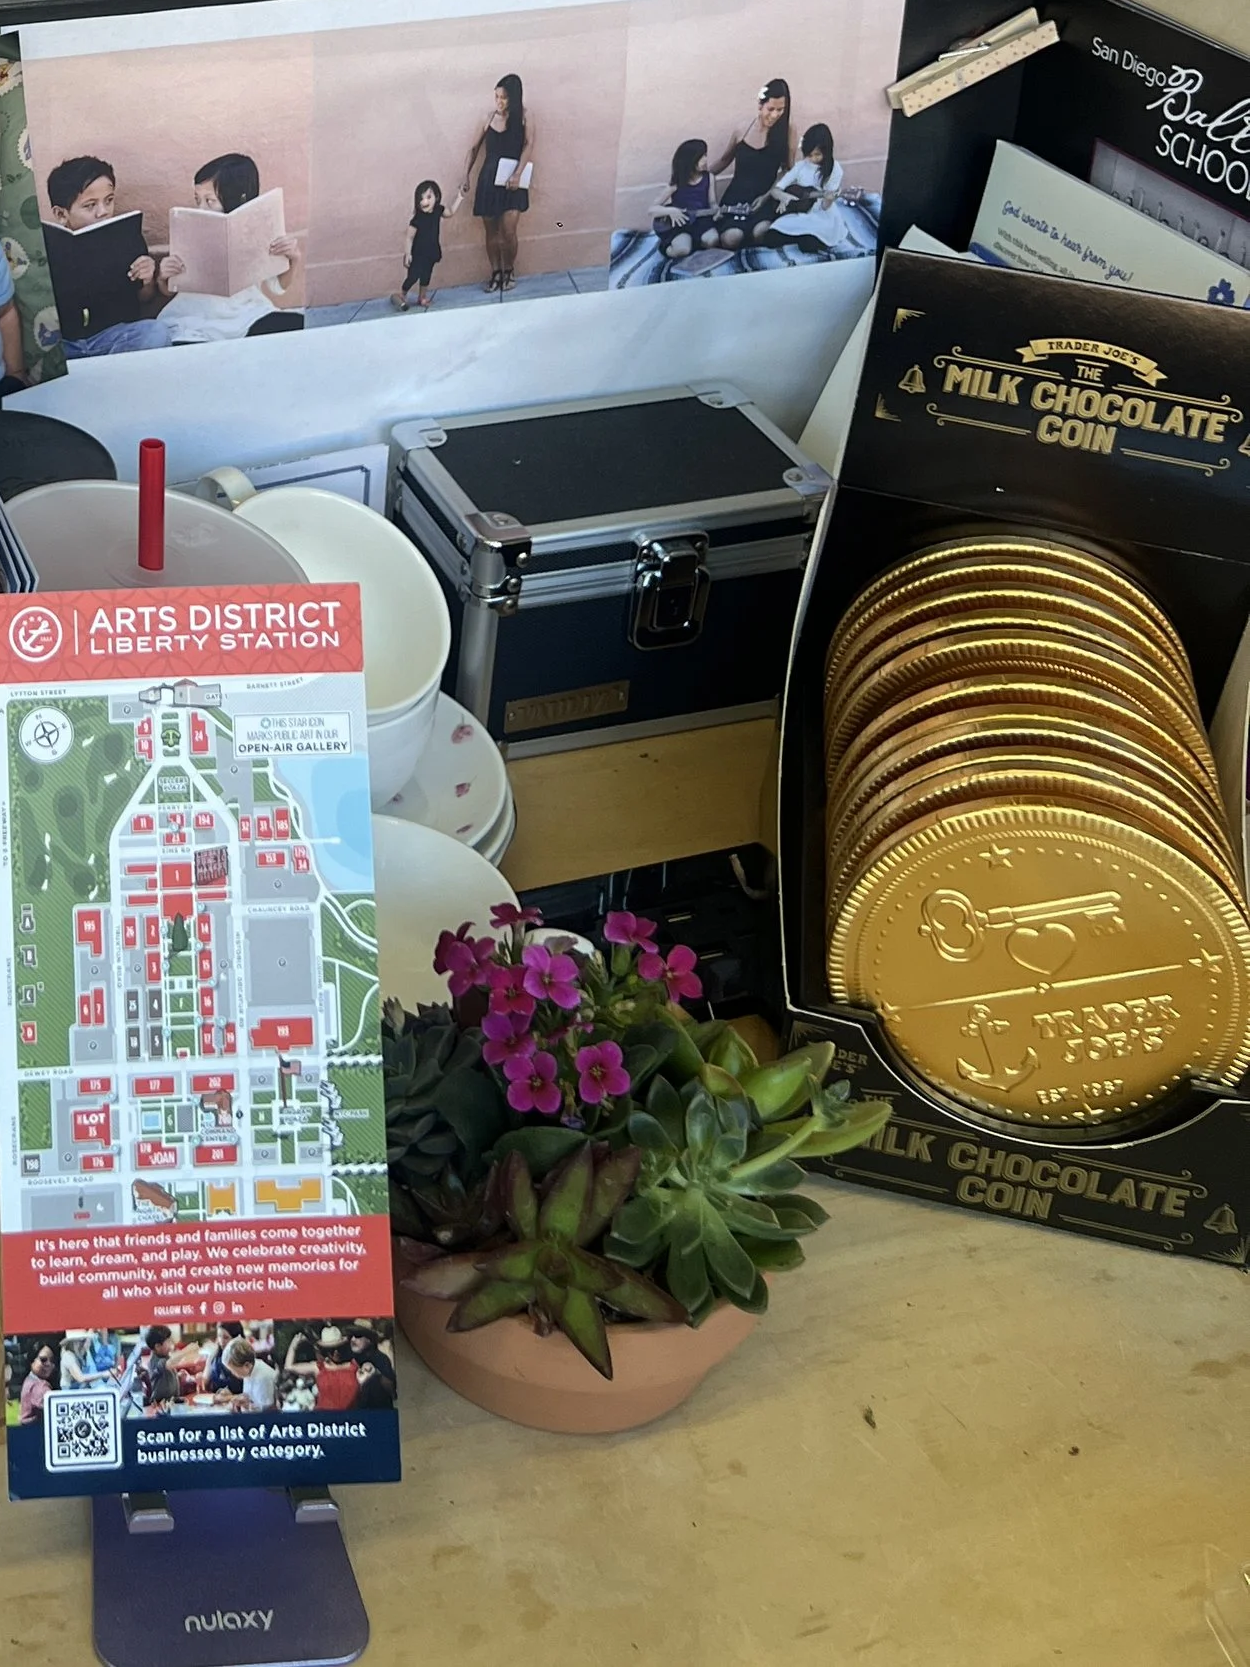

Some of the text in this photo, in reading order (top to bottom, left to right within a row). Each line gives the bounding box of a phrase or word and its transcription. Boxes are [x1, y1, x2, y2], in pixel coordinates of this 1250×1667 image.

[1092, 36, 1167, 87] San Diego
[1001, 200, 1134, 283] God wants to hear from you!
[1047, 341, 1142, 366] TRADER JOE'S
[1077, 364, 1104, 381] THE
[942, 364, 1230, 443] MILK CHOCOLATE
[1036, 414, 1117, 454] COIN
[89, 601, 341, 634] ARTS DISTRICT
[90, 631, 339, 655] LIBERTY STATION
[246, 730, 273, 741] MARKS
[274, 730, 299, 740] PUBLIC
[271, 718, 287, 728] THIS
[289, 717, 307, 727] STAR
[238, 741, 348, 753] OPEN-AIR GALLERY
[1033, 994, 1181, 1038] TRADER
[1063, 1026, 1164, 1063] JOE'S
[82, 1113, 106, 1124] LOT
[151, 1152, 175, 1164] JOAN
[861, 1125, 1191, 1218] ILK CHOCOLATE
[956, 1175, 1054, 1220] COIN
[35, 1224, 361, 1251] It's here that friends and families come together
[31, 1241, 366, 1269] to learn, dream, and play. We celebrate creativity,
[39, 1257, 359, 1286] build community, and create new memories for
[102, 1277, 297, 1299] all who visit our historic hub.
[136, 1422, 366, 1445] Scan for a list of Arts District
[137, 1443, 325, 1464] businesses by category.
[184, 1608, 274, 1633] nulaxy
